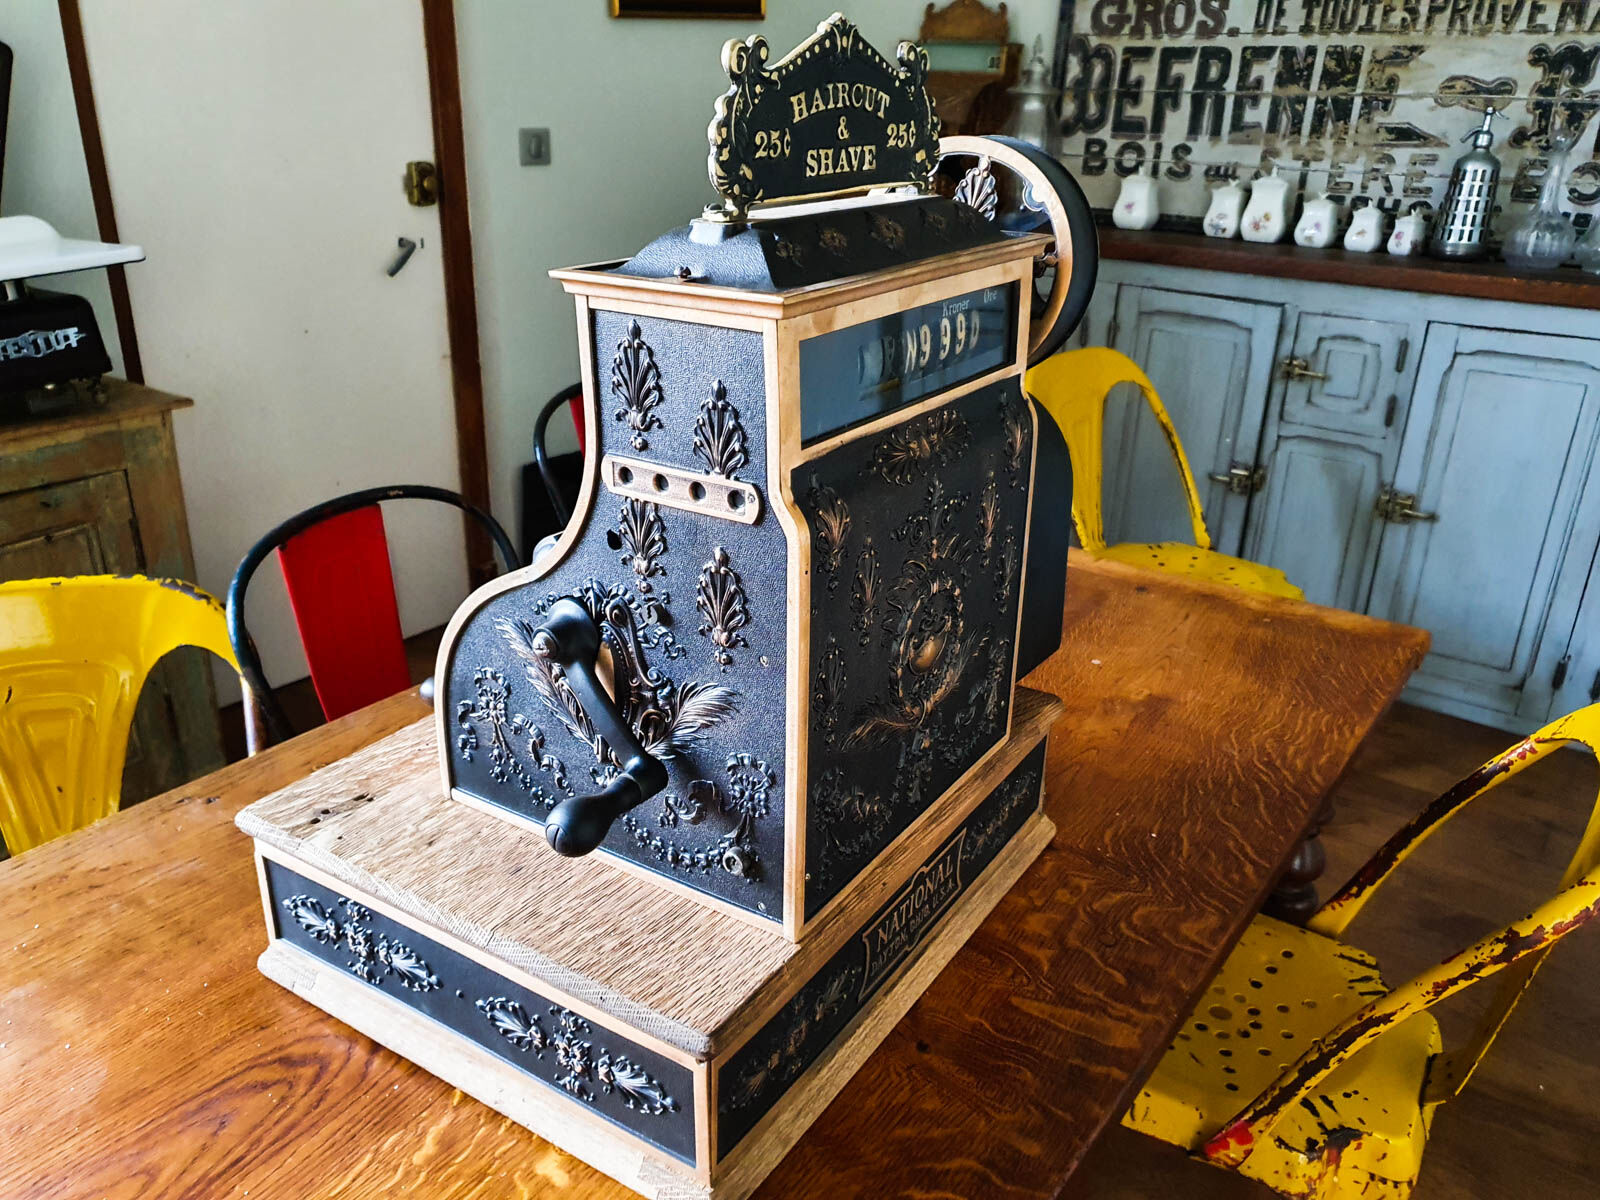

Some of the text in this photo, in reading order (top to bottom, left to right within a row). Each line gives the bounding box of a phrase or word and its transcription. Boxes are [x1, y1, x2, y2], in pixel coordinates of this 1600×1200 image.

[790, 82, 890, 124] HAIRCUT
[1056, 33, 1450, 148] DEFRENNE
[755, 115, 917, 159] 25¢ & 25¢
[1082, 137, 1193, 181] BOIS
[805, 145, 877, 178] SHAVE
[876, 855, 953, 953] NATIONAL
